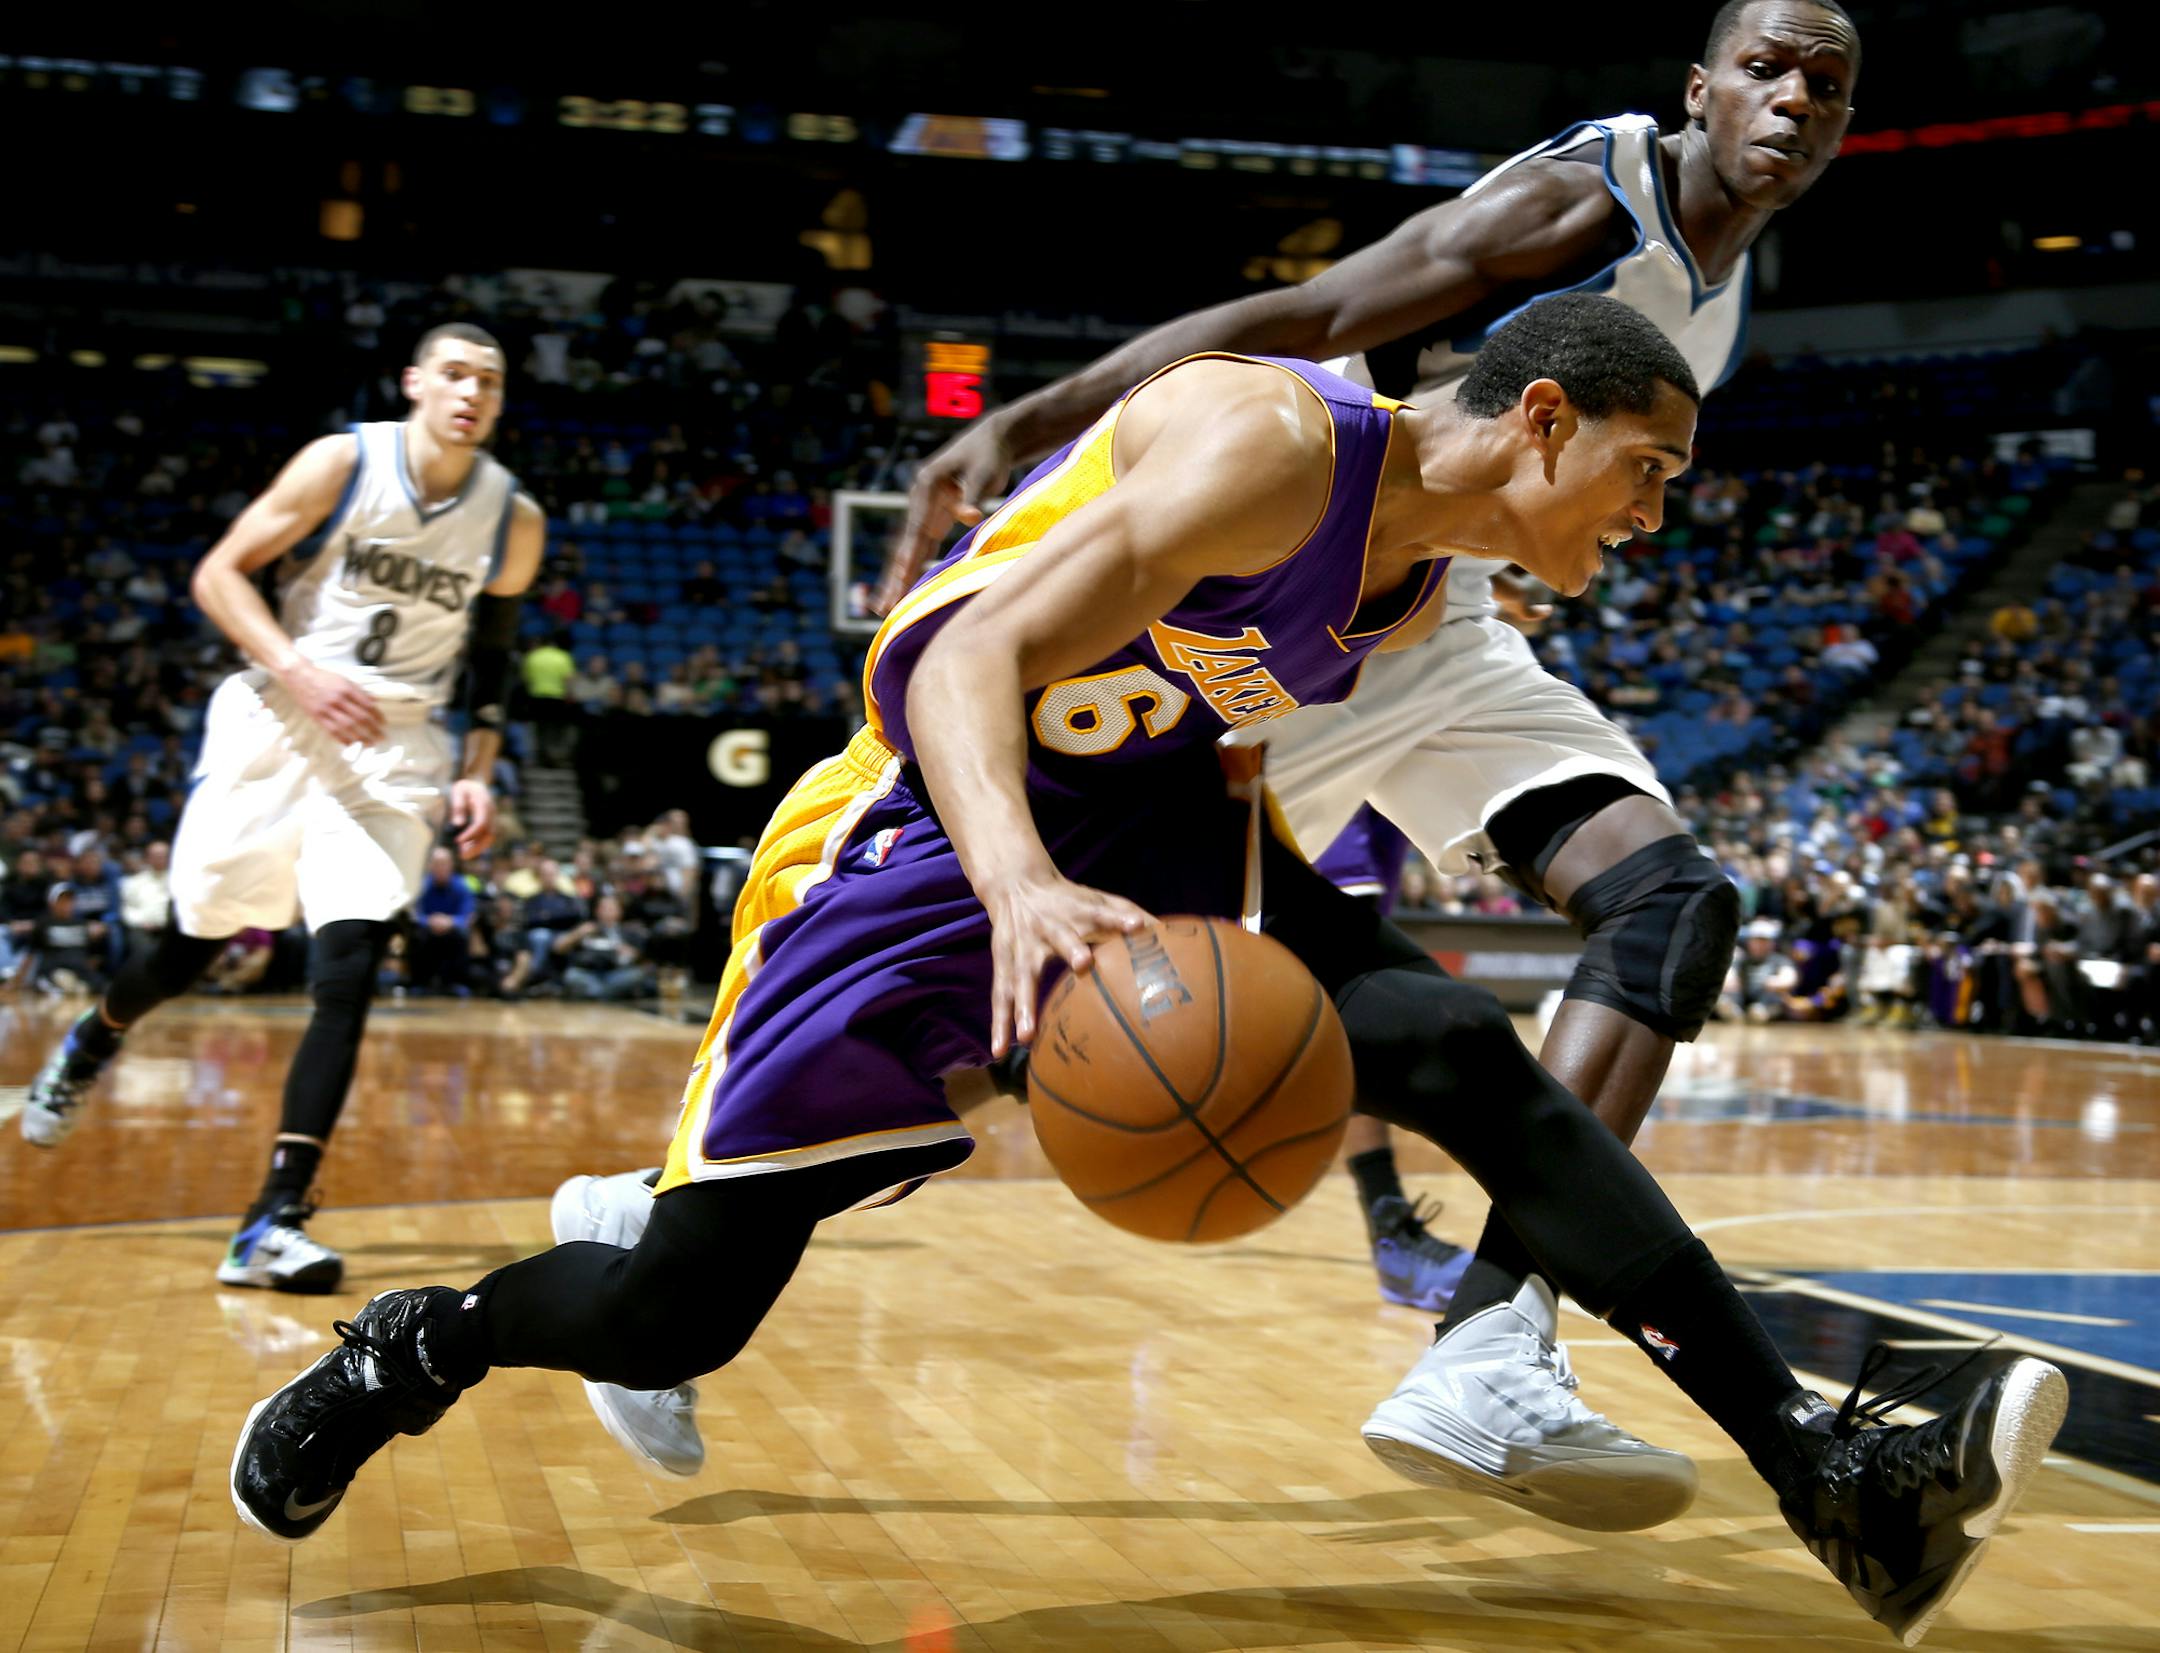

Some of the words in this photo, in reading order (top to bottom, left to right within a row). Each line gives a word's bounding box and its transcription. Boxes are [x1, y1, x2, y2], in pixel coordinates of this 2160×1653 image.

[344, 533, 472, 613] WOLVES
[354, 608, 398, 667] 8
[1031, 664, 1191, 756] 6
[706, 728, 770, 788] G
